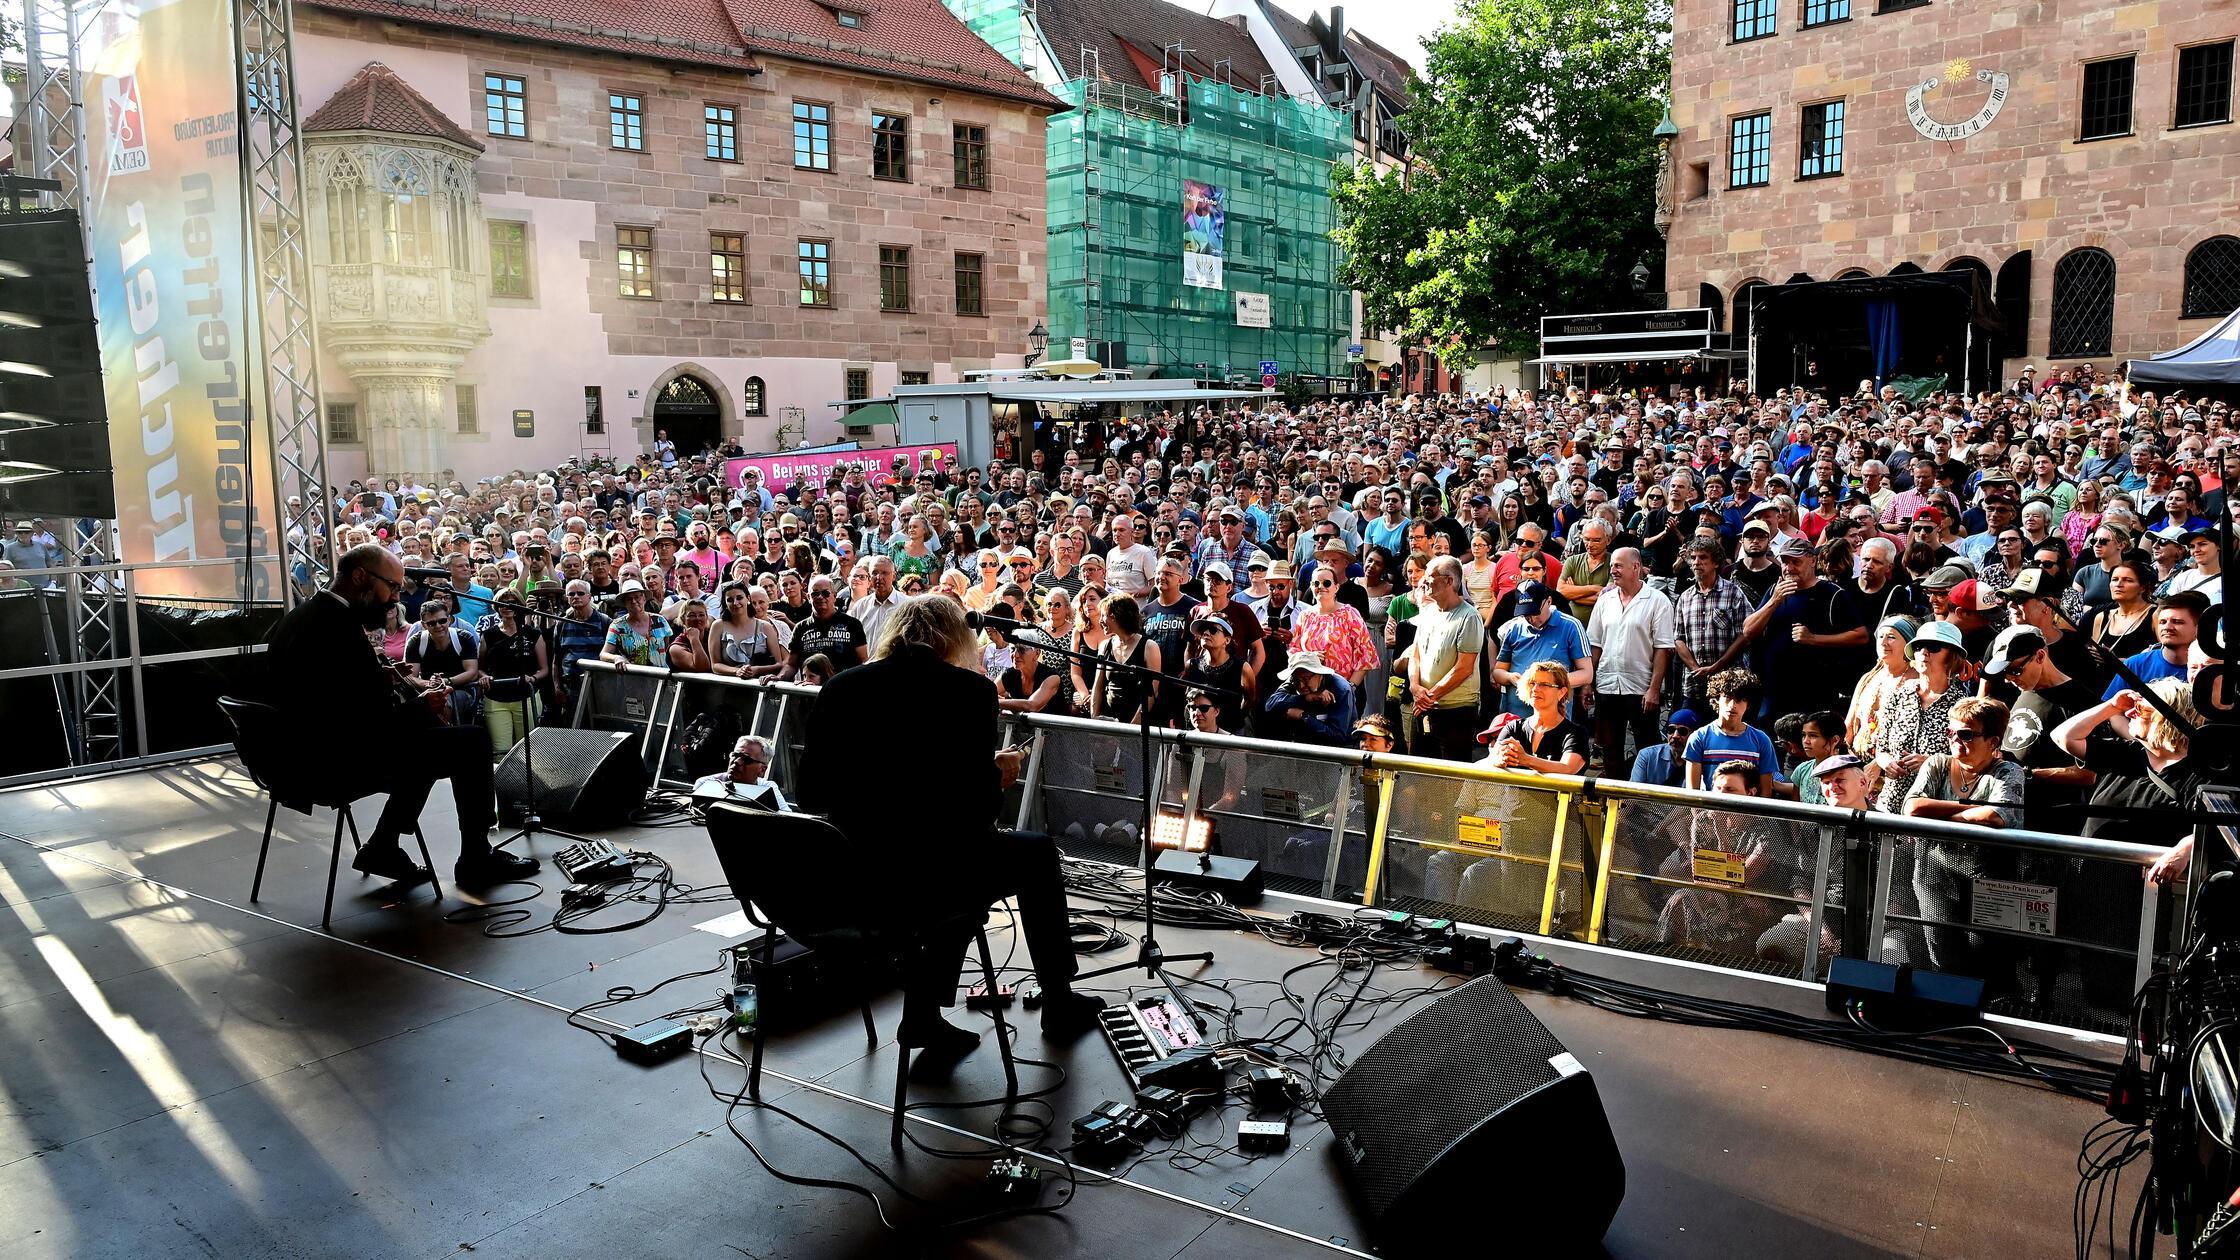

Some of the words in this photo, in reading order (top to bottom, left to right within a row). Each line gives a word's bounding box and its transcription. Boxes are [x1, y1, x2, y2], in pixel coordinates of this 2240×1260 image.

[772, 462, 793, 479] Bei
[795, 463, 819, 477] uns
[821, 464, 834, 476] ist
[801, 631, 822, 642] CAMP
[827, 630, 851, 639] DAVID
[1726, 853, 1743, 862] BOS
[1980, 881, 2049, 895] www.bos-franken.de
[2025, 900, 2050, 914] BOS
